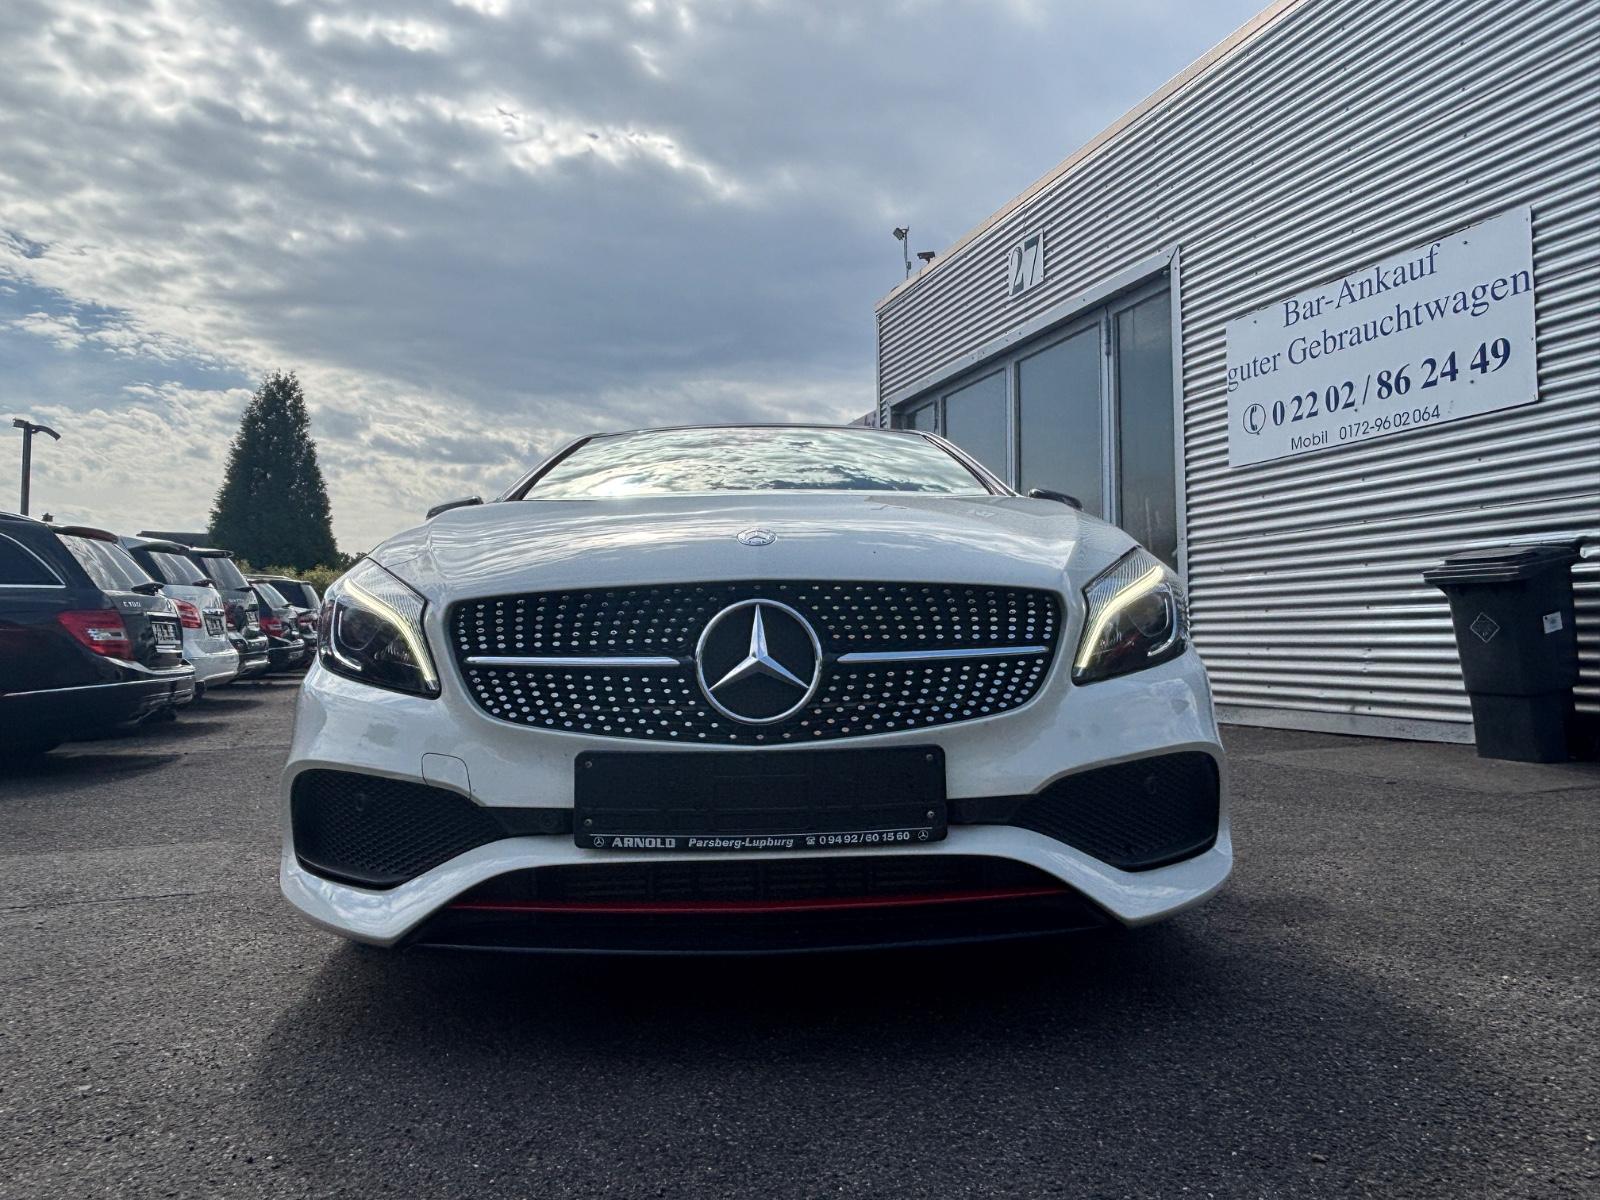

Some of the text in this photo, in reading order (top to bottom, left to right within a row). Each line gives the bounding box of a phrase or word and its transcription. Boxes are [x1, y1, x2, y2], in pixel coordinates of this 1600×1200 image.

[1010, 234, 1040, 295] 27
[1283, 243, 1441, 328] Bar-Ankauf
[1227, 269, 1531, 392] guter Gebrauchtwagen
[1291, 430, 1328, 450] Mobil
[612, 837, 676, 848] ARNOLD
[688, 837, 794, 849] Parsberg-Lupburg
